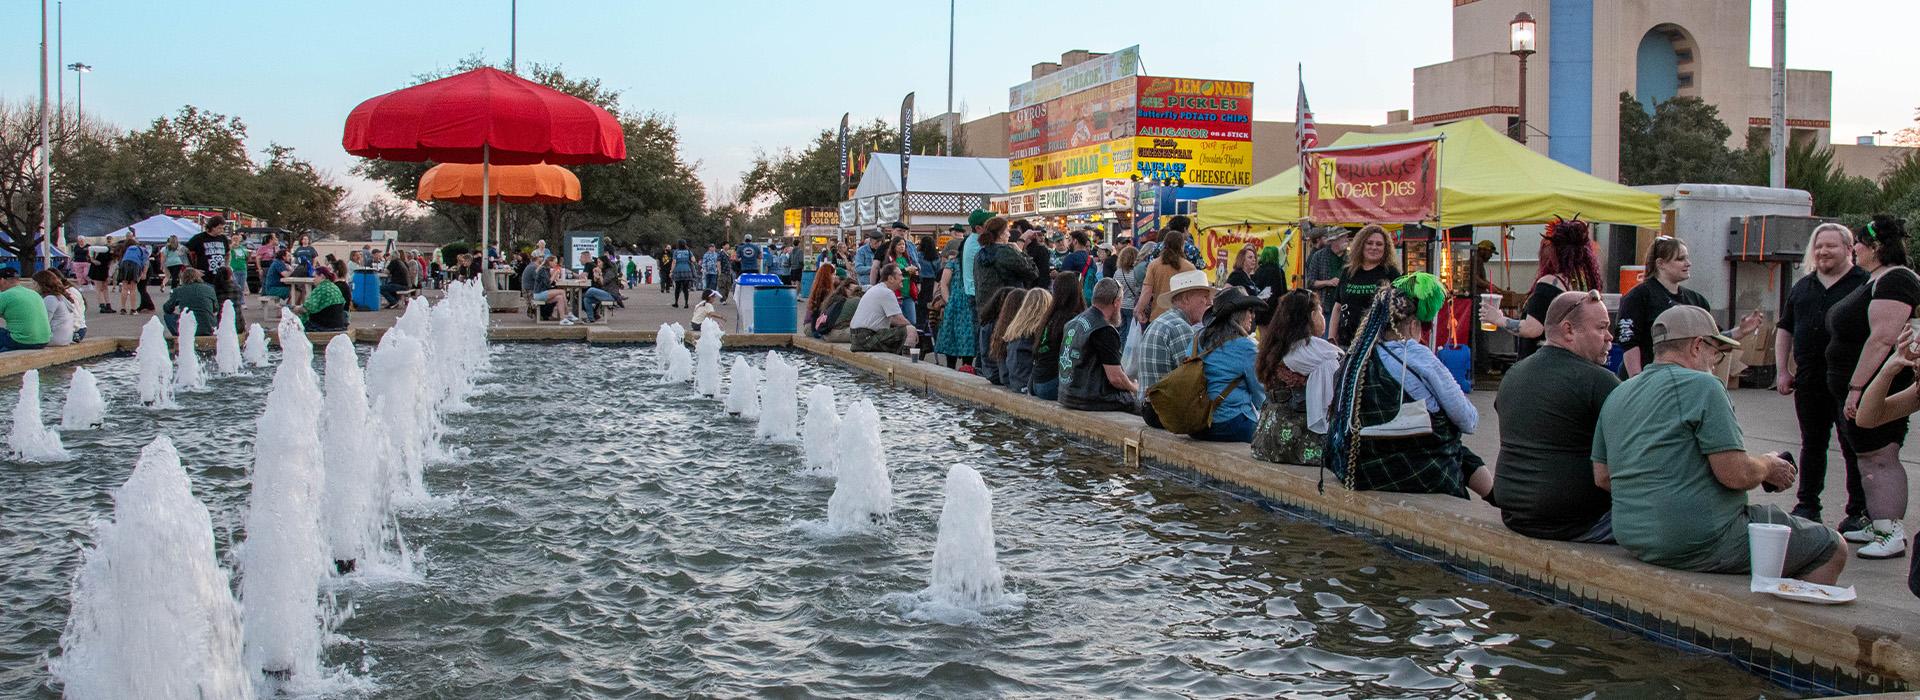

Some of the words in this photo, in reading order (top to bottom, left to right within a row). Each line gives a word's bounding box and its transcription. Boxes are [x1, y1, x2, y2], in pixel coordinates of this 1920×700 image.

[1167, 95, 1239, 111] PICKLES
[1017, 103, 1047, 122] GYROS
[1137, 109, 1179, 120] Butterfly
[1180, 111, 1218, 121] POTATO
[1221, 114, 1249, 123] CHIPS
[904, 108, 912, 165] GUINNESS
[1140, 126, 1209, 138] ALLIGATOR
[1153, 138, 1178, 149] Philly
[1138, 147, 1193, 159] CHEESESTEAK
[1199, 153, 1222, 166] Chocolate
[1223, 154, 1244, 167] Dipped
[1137, 161, 1187, 172] SAUSAGE
[1142, 170, 1181, 181] WRAPS
[1189, 169, 1250, 185] CHEESECAKE
[1335, 181, 1378, 198] MEAT
[1380, 180, 1416, 207] PIES
